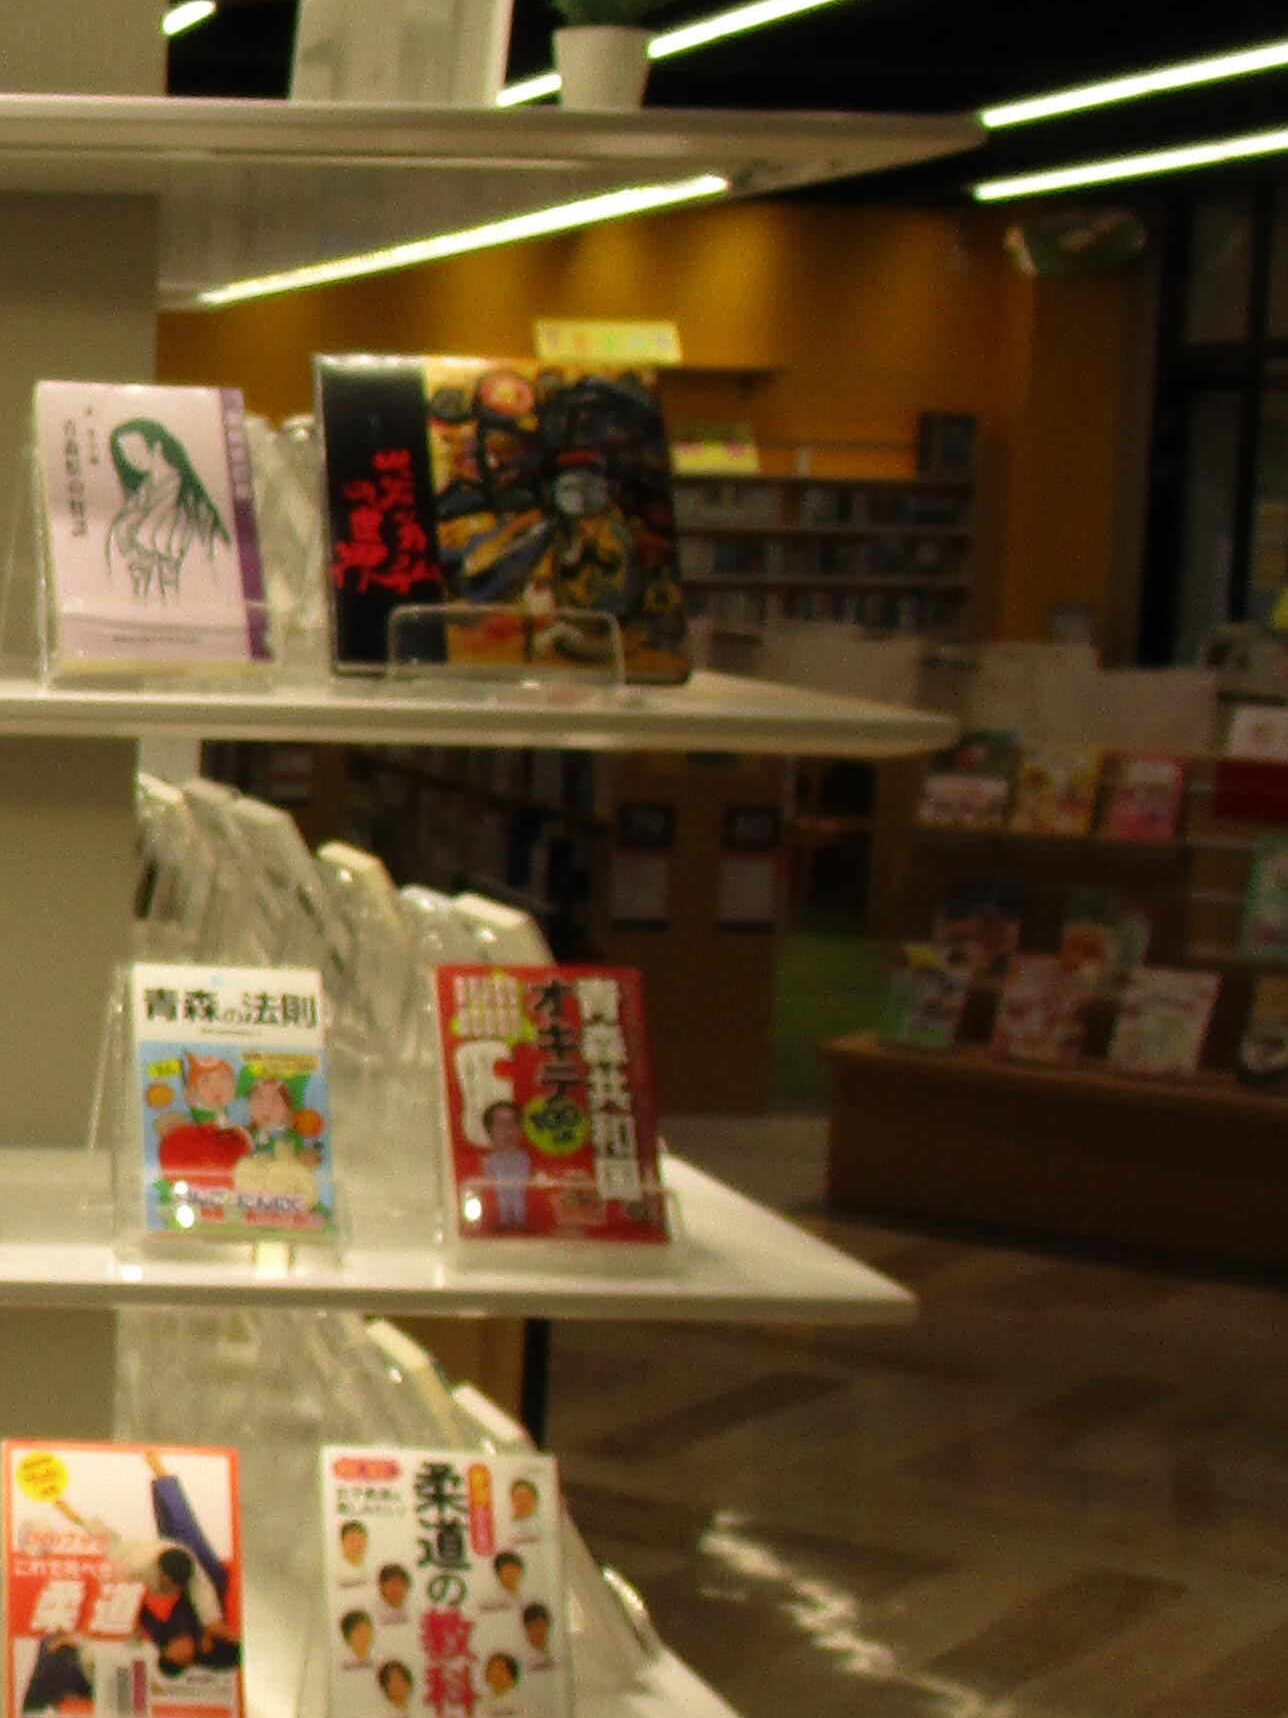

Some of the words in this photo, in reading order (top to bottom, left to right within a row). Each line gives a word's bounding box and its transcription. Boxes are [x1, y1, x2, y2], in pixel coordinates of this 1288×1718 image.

[143, 987, 319, 1030] 青森の法則
